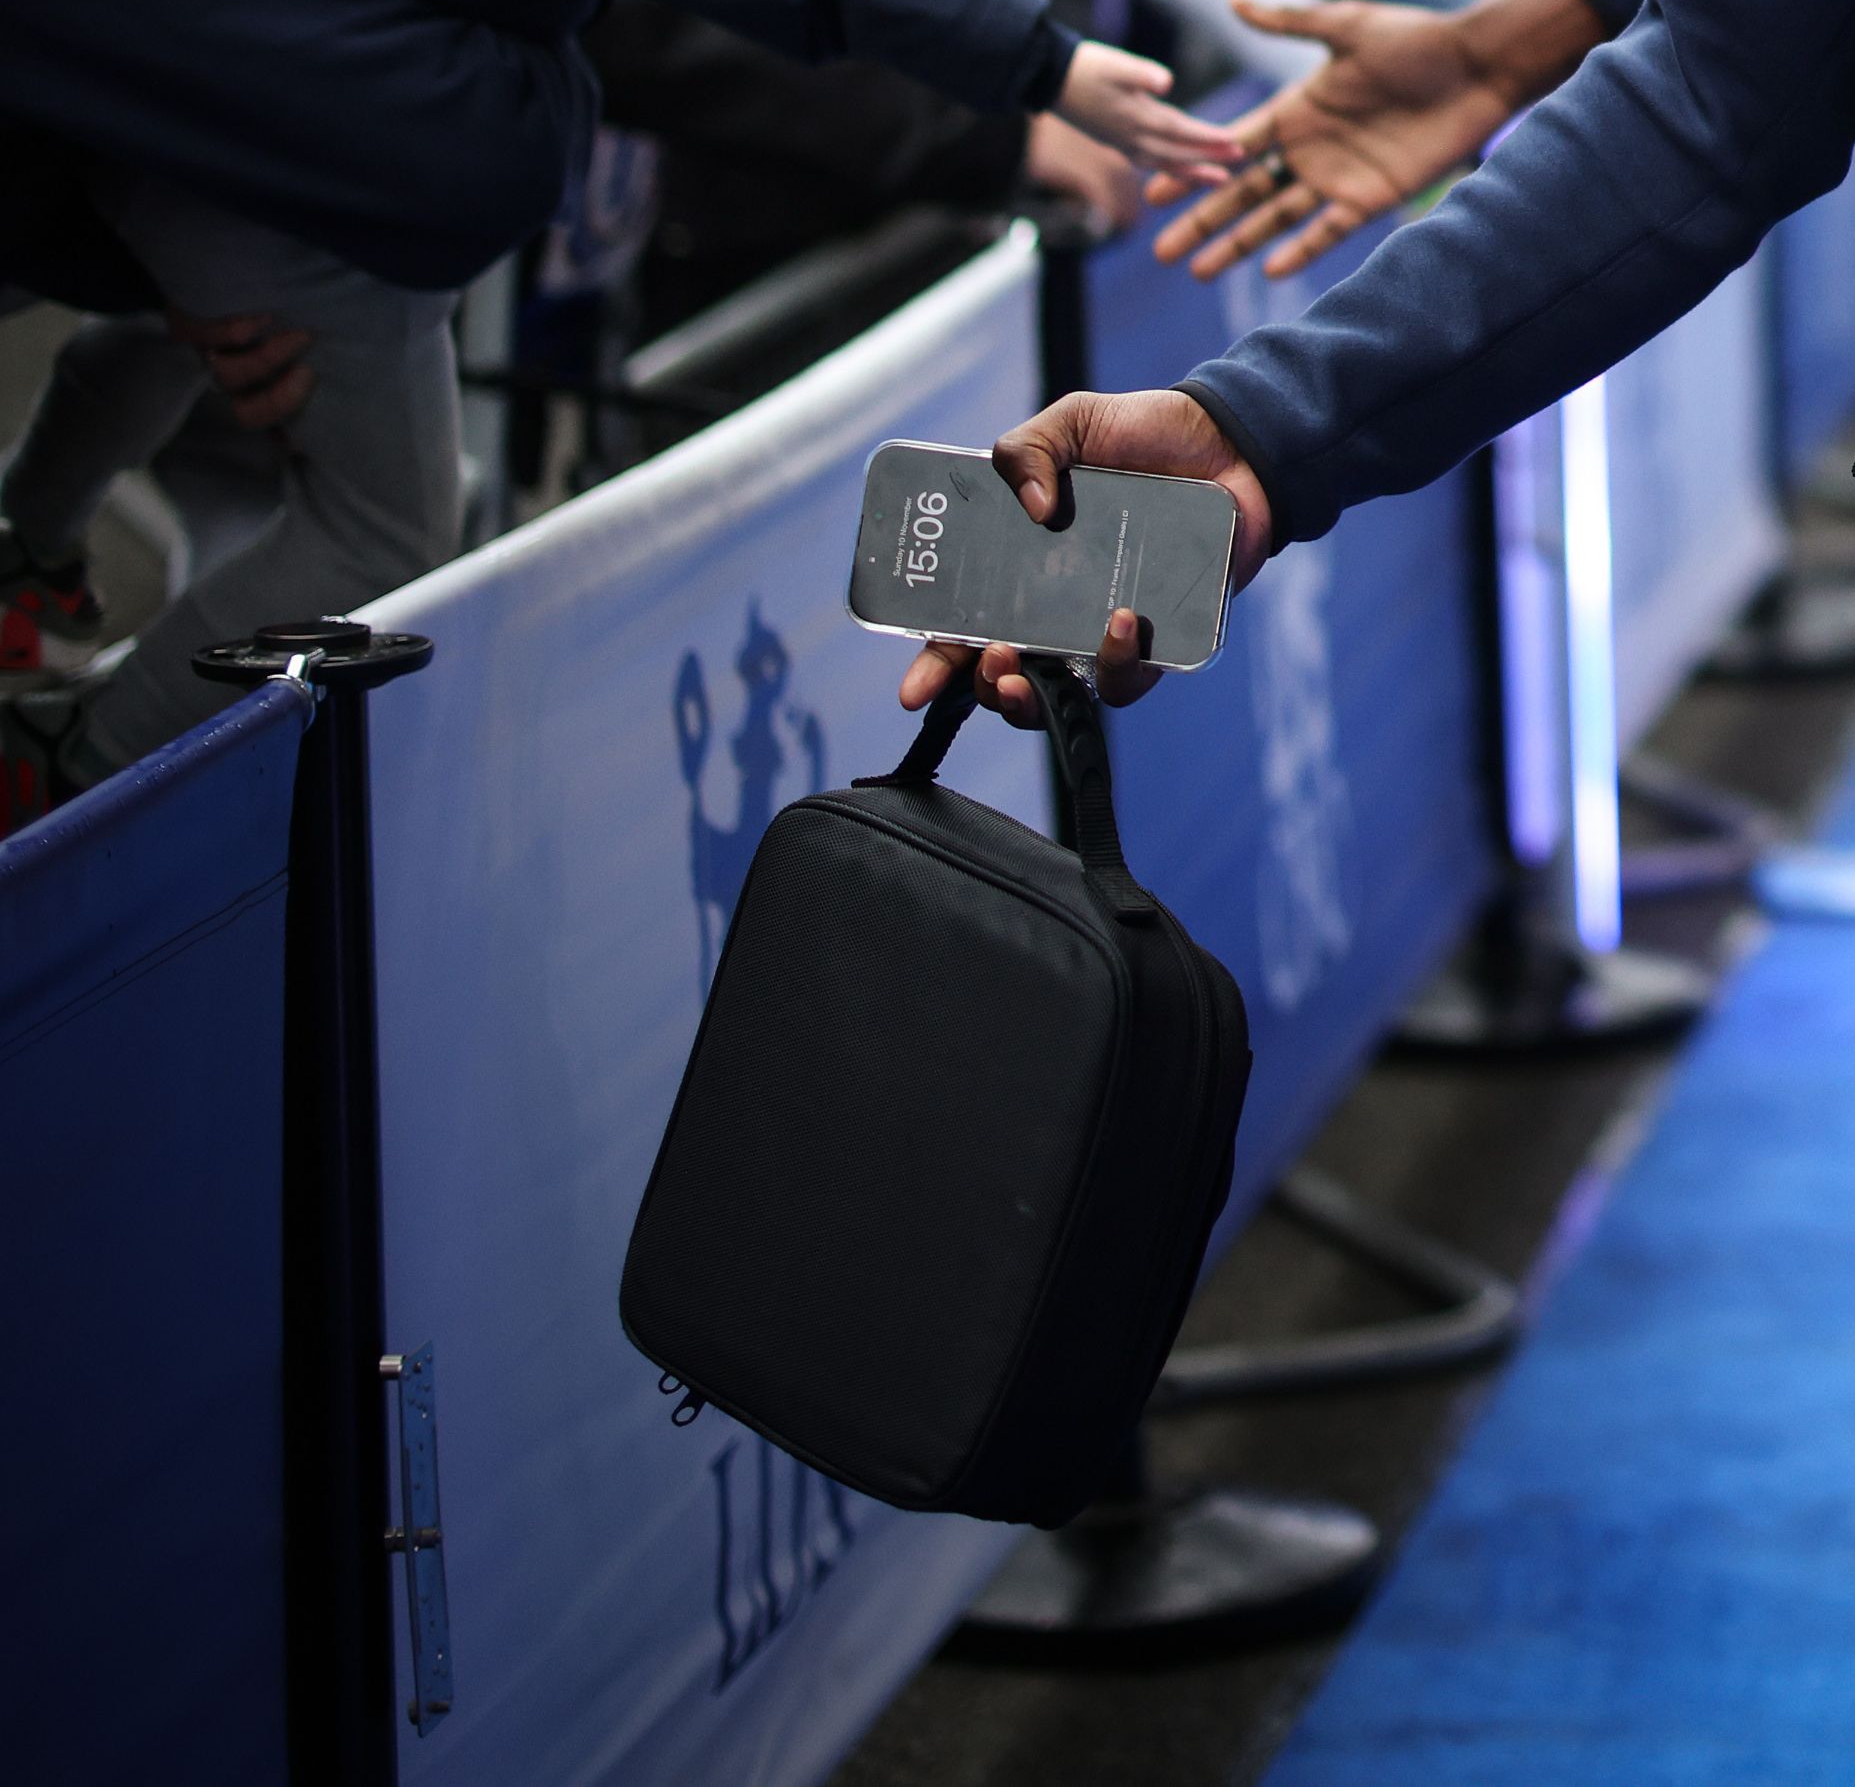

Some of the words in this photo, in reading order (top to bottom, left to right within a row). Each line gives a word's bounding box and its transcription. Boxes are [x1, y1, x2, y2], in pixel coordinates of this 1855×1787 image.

[900, 497, 912, 536] November
[898, 537, 906, 546] 10
[905, 491, 948, 588] 15:06
[893, 550, 905, 577] Sunday
[1114, 540, 1124, 567] Lampard
[1111, 568, 1121, 586] Frank
[1107, 596, 1115, 609] TOP
